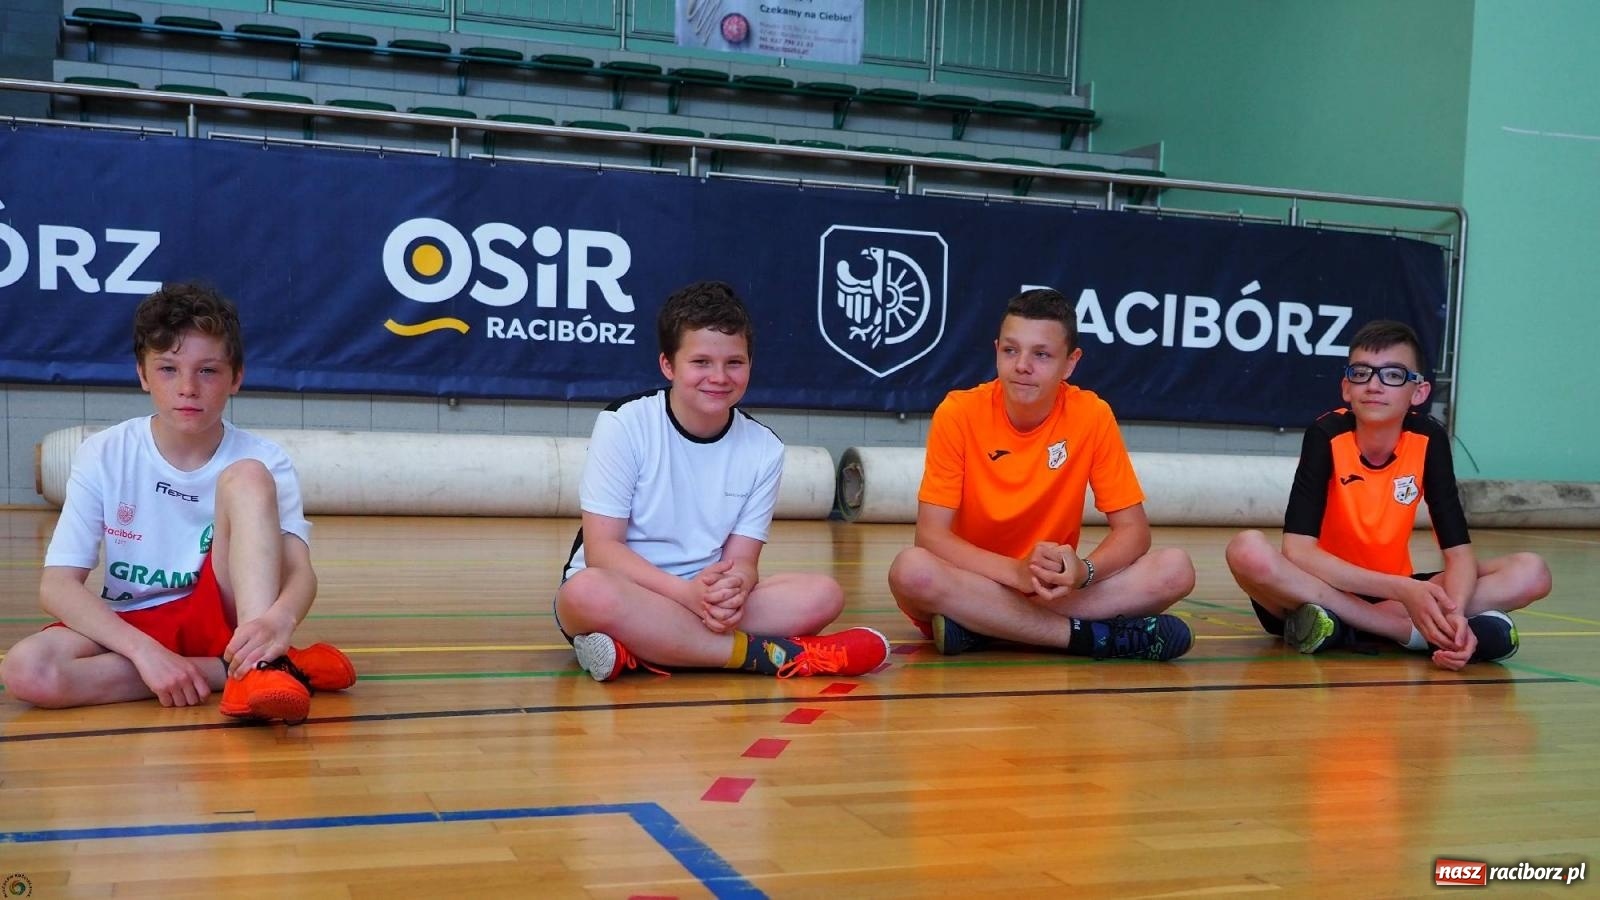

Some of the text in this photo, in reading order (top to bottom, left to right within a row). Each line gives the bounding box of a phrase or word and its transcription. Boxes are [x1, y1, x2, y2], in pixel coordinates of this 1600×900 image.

[760, 4, 852, 22] Czekamy na Ciebie!
[487, 314, 635, 345] RACIBÓRZ
[1021, 280, 1353, 357] ACIBÓRZ
[109, 561, 200, 589] GRAM
